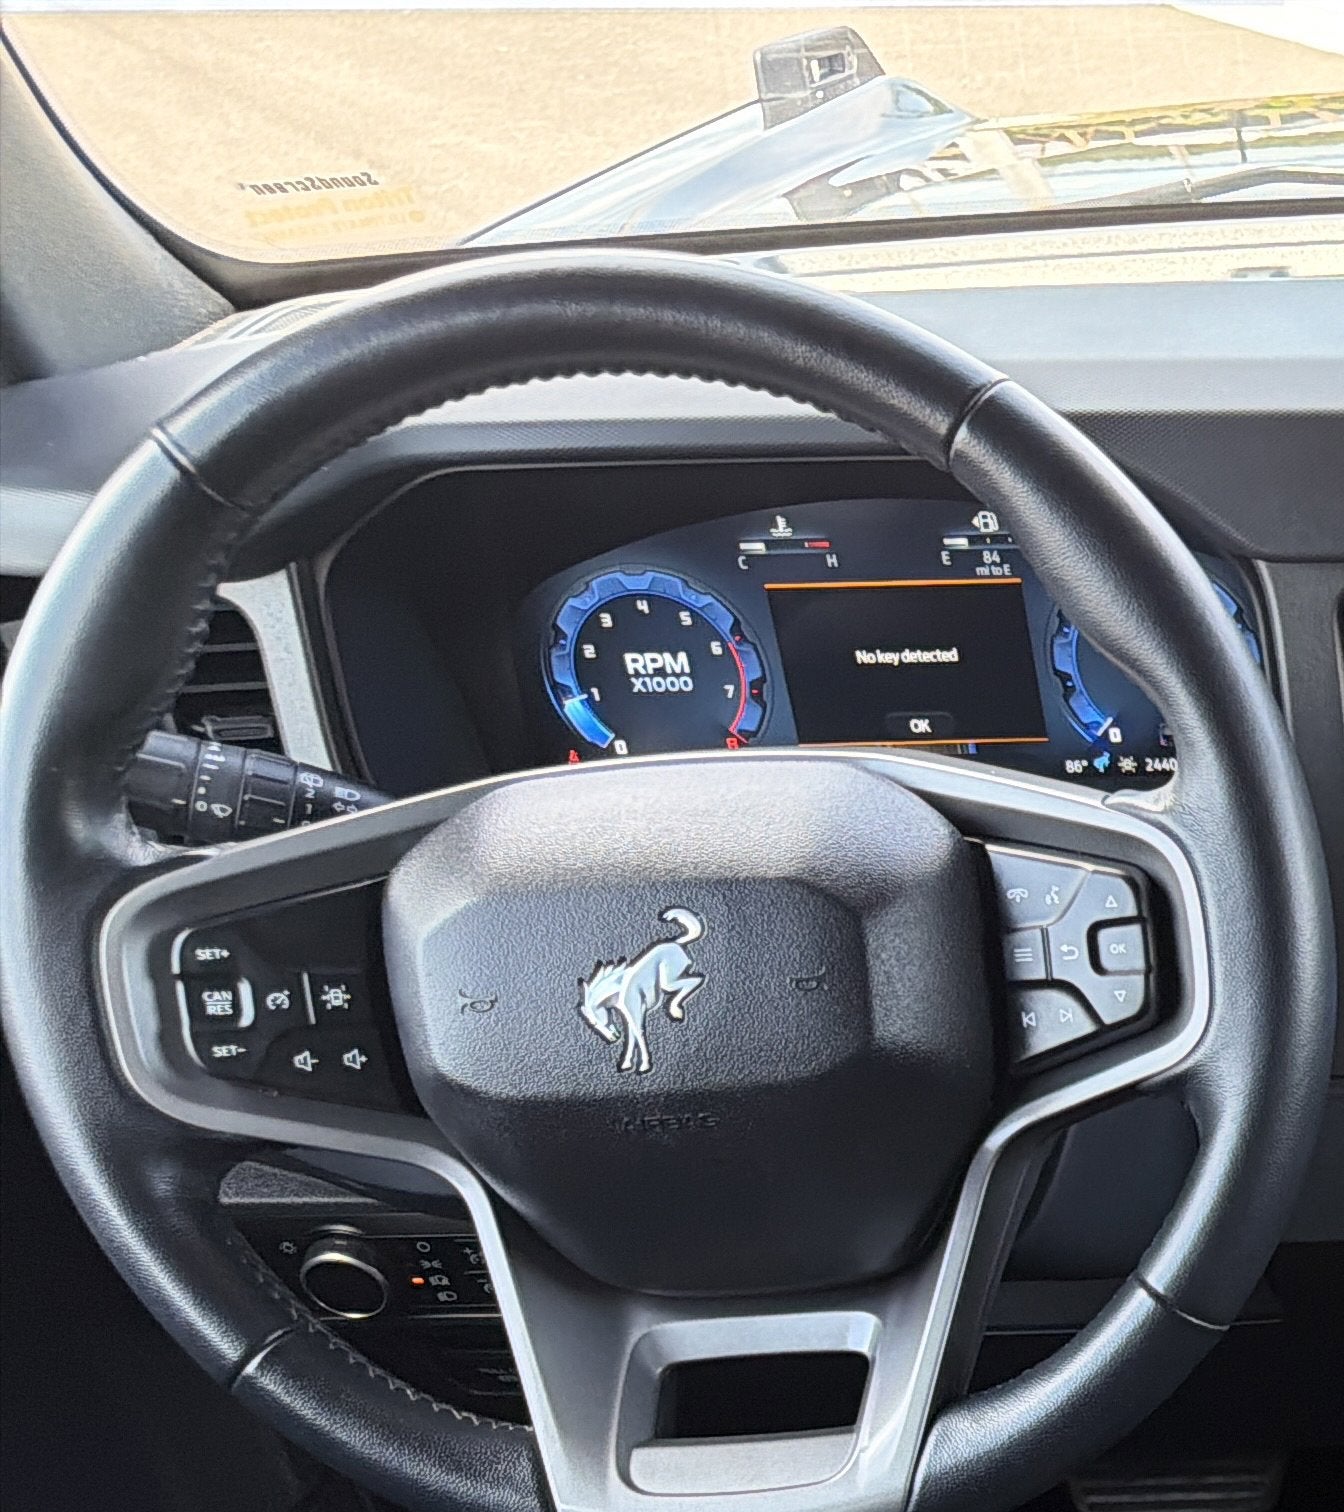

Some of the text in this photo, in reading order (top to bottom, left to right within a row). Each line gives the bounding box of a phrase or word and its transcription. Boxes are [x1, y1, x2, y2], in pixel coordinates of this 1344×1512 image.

[738, 555, 748, 570] C
[826, 554, 839, 568] H
[942, 551, 951, 565] E
[982, 551, 1001, 564] 84
[976, 563, 1012, 576] mi to E
[636, 600, 650, 615] 4
[600, 612, 613, 628] 3
[679, 611, 692, 626] 5
[583, 644, 597, 659] 2
[710, 641, 723, 655] 6
[624, 651, 691, 675] RPM
[855, 647, 959, 666] No key detected
[631, 676, 694, 694] X1000
[724, 684, 735, 699] 7
[591, 687, 601, 701] 1
[909, 718, 932, 733] OK
[1108, 727, 1122, 743] 0
[614, 739, 628, 755] 0
[1109, 943, 1127, 954] OK
[202, 991, 233, 1001] CAN
[206, 1005, 234, 1015] RES
